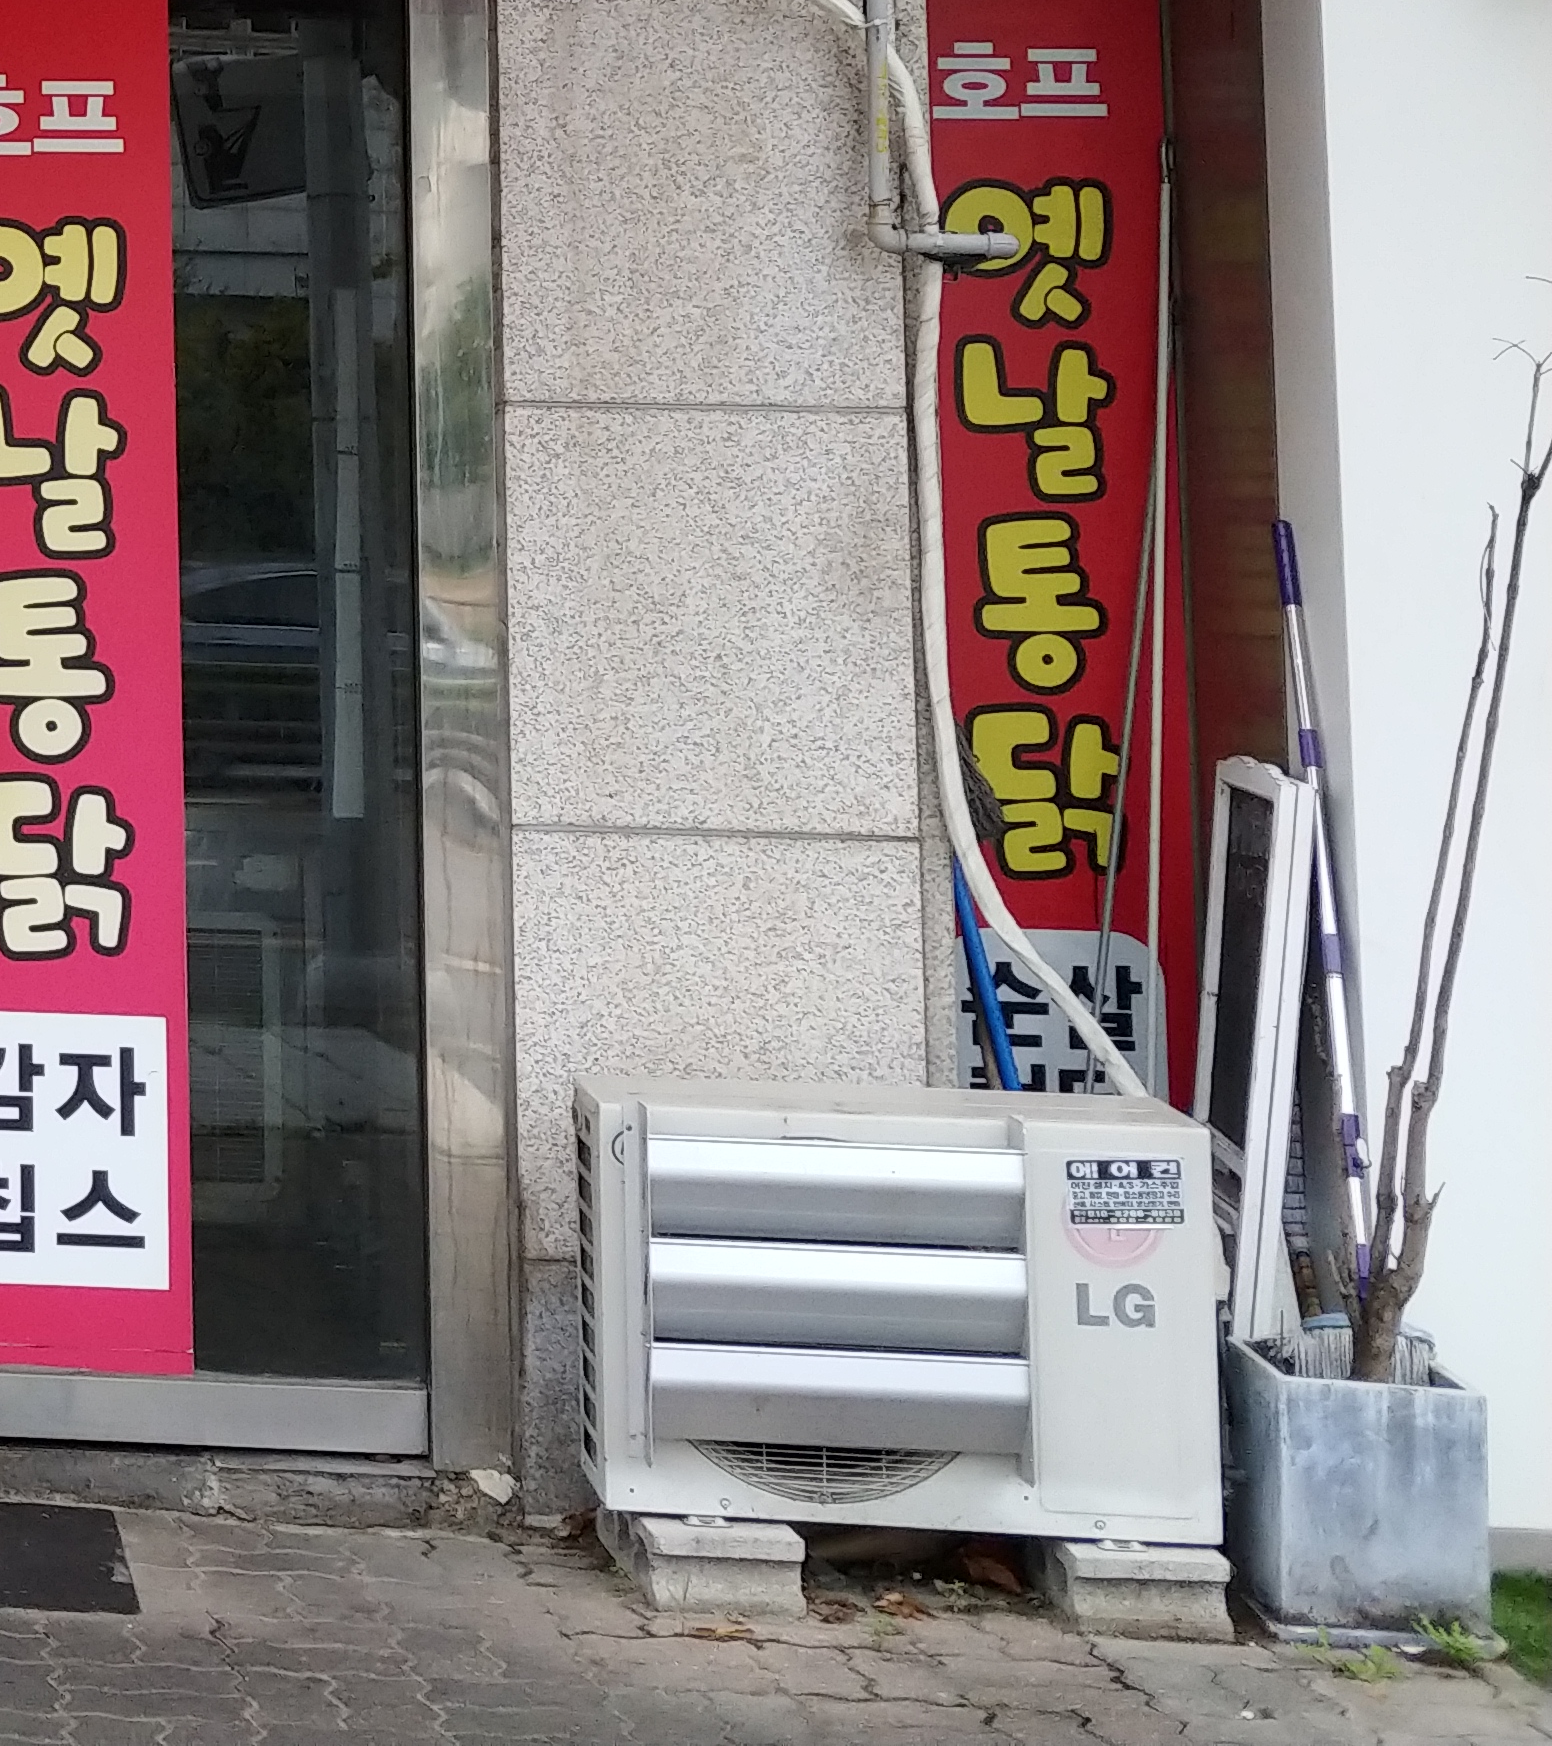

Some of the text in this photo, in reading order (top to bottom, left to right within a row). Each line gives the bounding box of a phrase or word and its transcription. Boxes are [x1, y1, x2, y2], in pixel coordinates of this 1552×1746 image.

[933, 42, 1108, 119] 호프
[1070, 1161, 1179, 1178] 에어컨
[1075, 1283, 1156, 1329] LG
